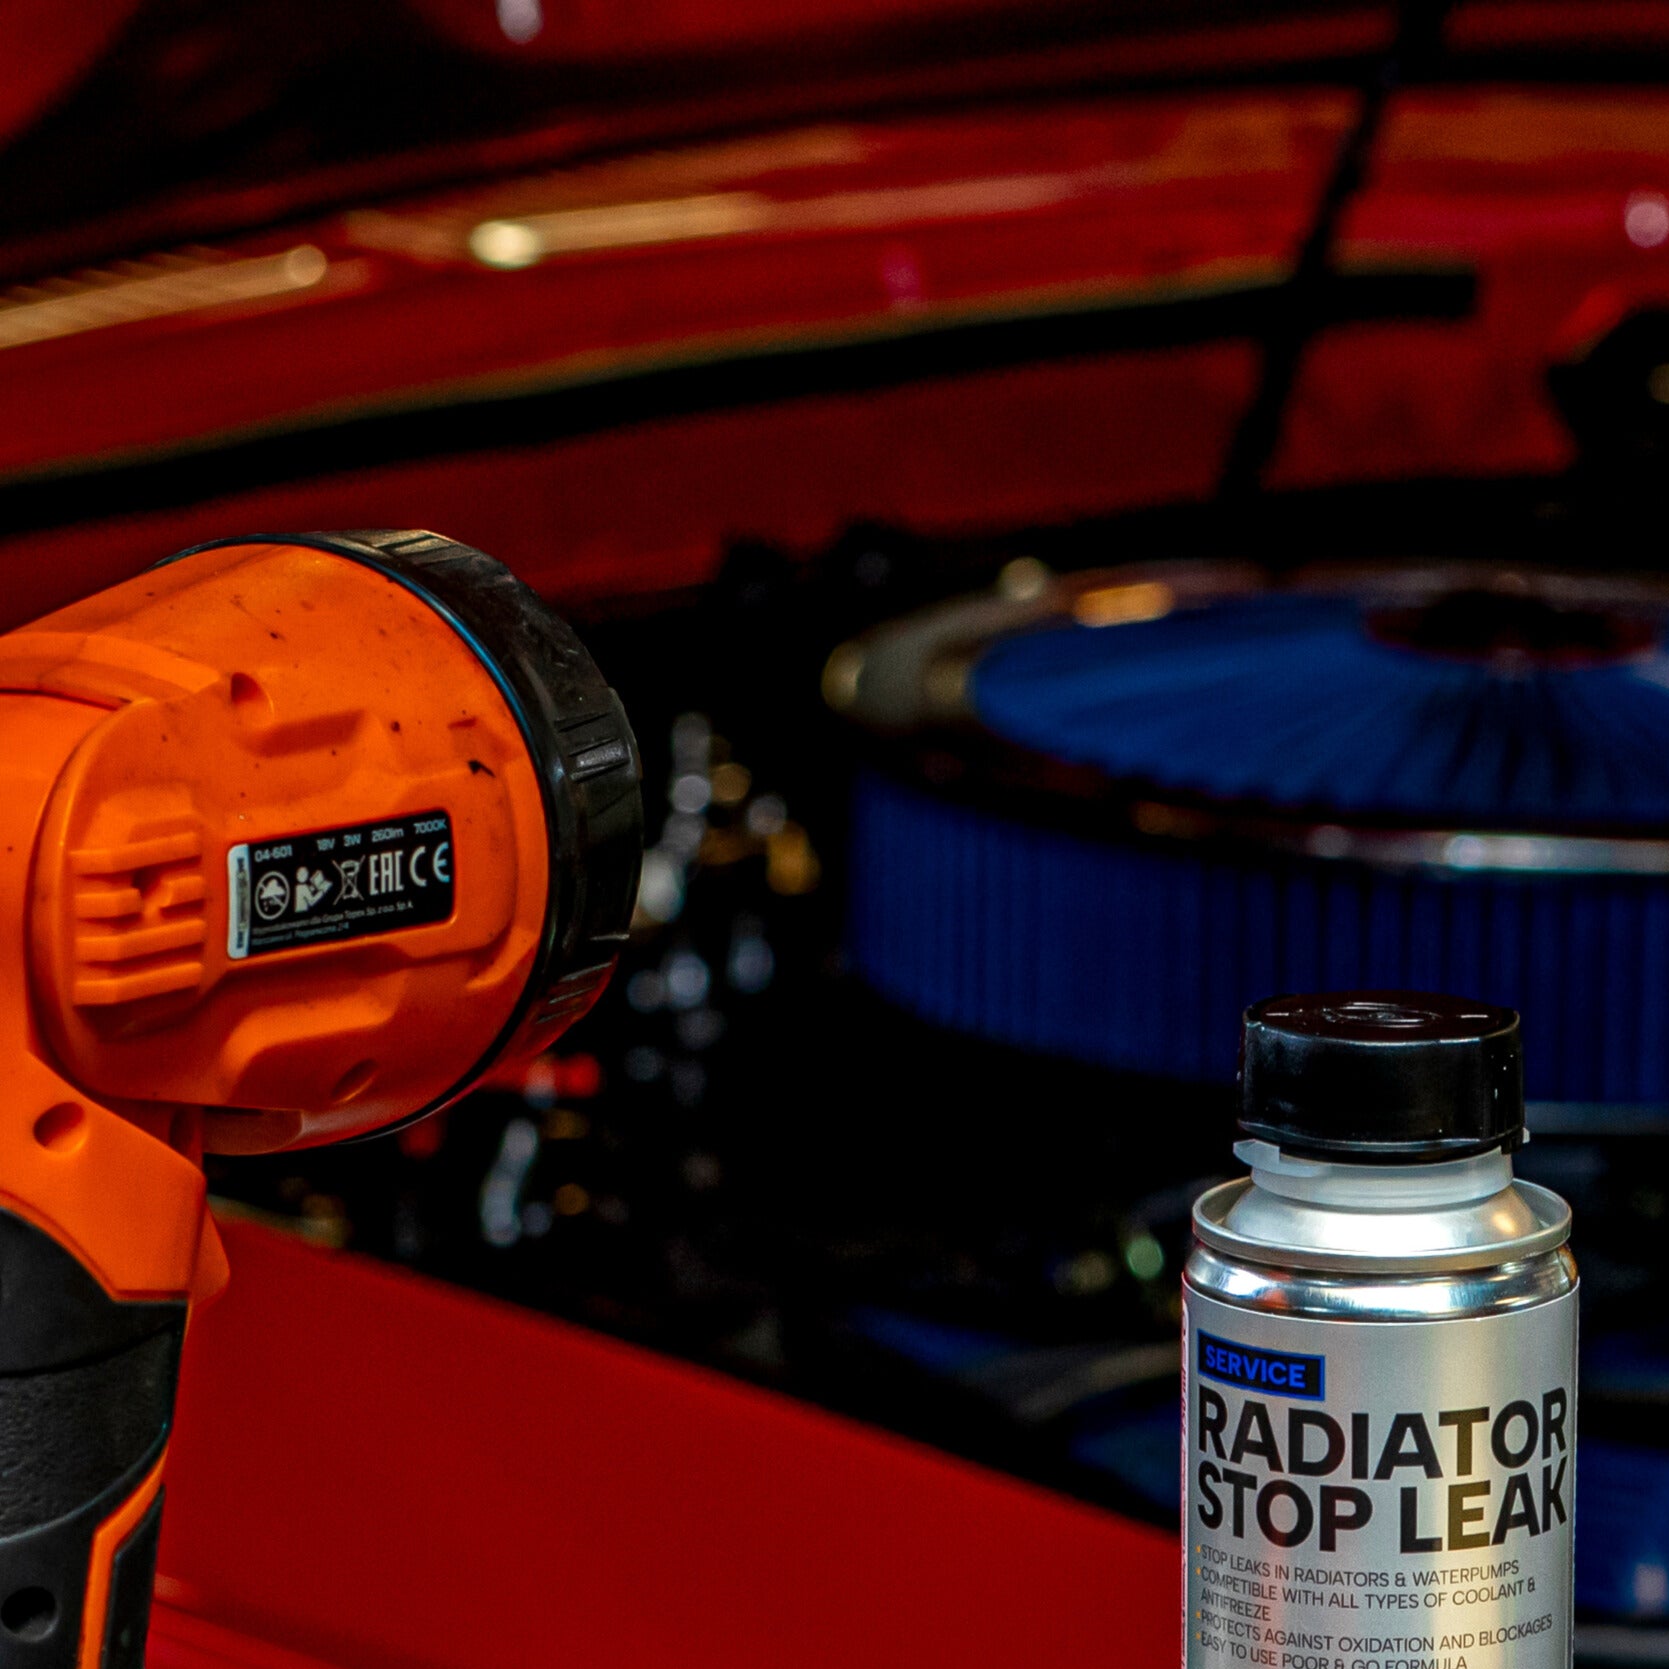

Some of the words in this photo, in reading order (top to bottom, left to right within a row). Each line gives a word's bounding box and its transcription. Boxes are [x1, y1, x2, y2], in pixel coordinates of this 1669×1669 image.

[413, 819, 447, 834] 7000K
[1205, 1344, 1306, 1389] SERVICE
[1199, 1384, 1568, 1481] RADIATOR
[1198, 1461, 1373, 1552] STOP
[1400, 1455, 1569, 1555] LEAK
[1201, 1544, 1228, 1566] STOP
[1230, 1554, 1270, 1577] LEAKS
[1275, 1565, 1289, 1580] IN
[1294, 1568, 1389, 1587] RADIATORS
[1395, 1572, 1406, 1587] &
[1413, 1560, 1519, 1586] WATERPUMPS
[1201, 1565, 1278, 1600] COMPETIBLE
[1282, 1587, 1324, 1606] WITH
[1328, 1592, 1359, 1609] ALL
[1365, 1593, 1419, 1609] TYPES
[1424, 1592, 1447, 1608] OF
[1452, 1580, 1524, 1606] COOLANT
[1527, 1577, 1536, 1593] &
[1201, 1588, 1271, 1621] ANTIFREEZE
[1201, 1609, 1260, 1641] PROTECTS
[1264, 1628, 1333, 1651] AGAINST
[1338, 1637, 1434, 1653] OXIDATION
[1439, 1634, 1475, 1650] AND
[1479, 1613, 1553, 1647] BLOCKAGES
[1201, 1631, 1226, 1651] EASY
[1230, 1641, 1247, 1659] TO
[1250, 1647, 1278, 1666] USE
